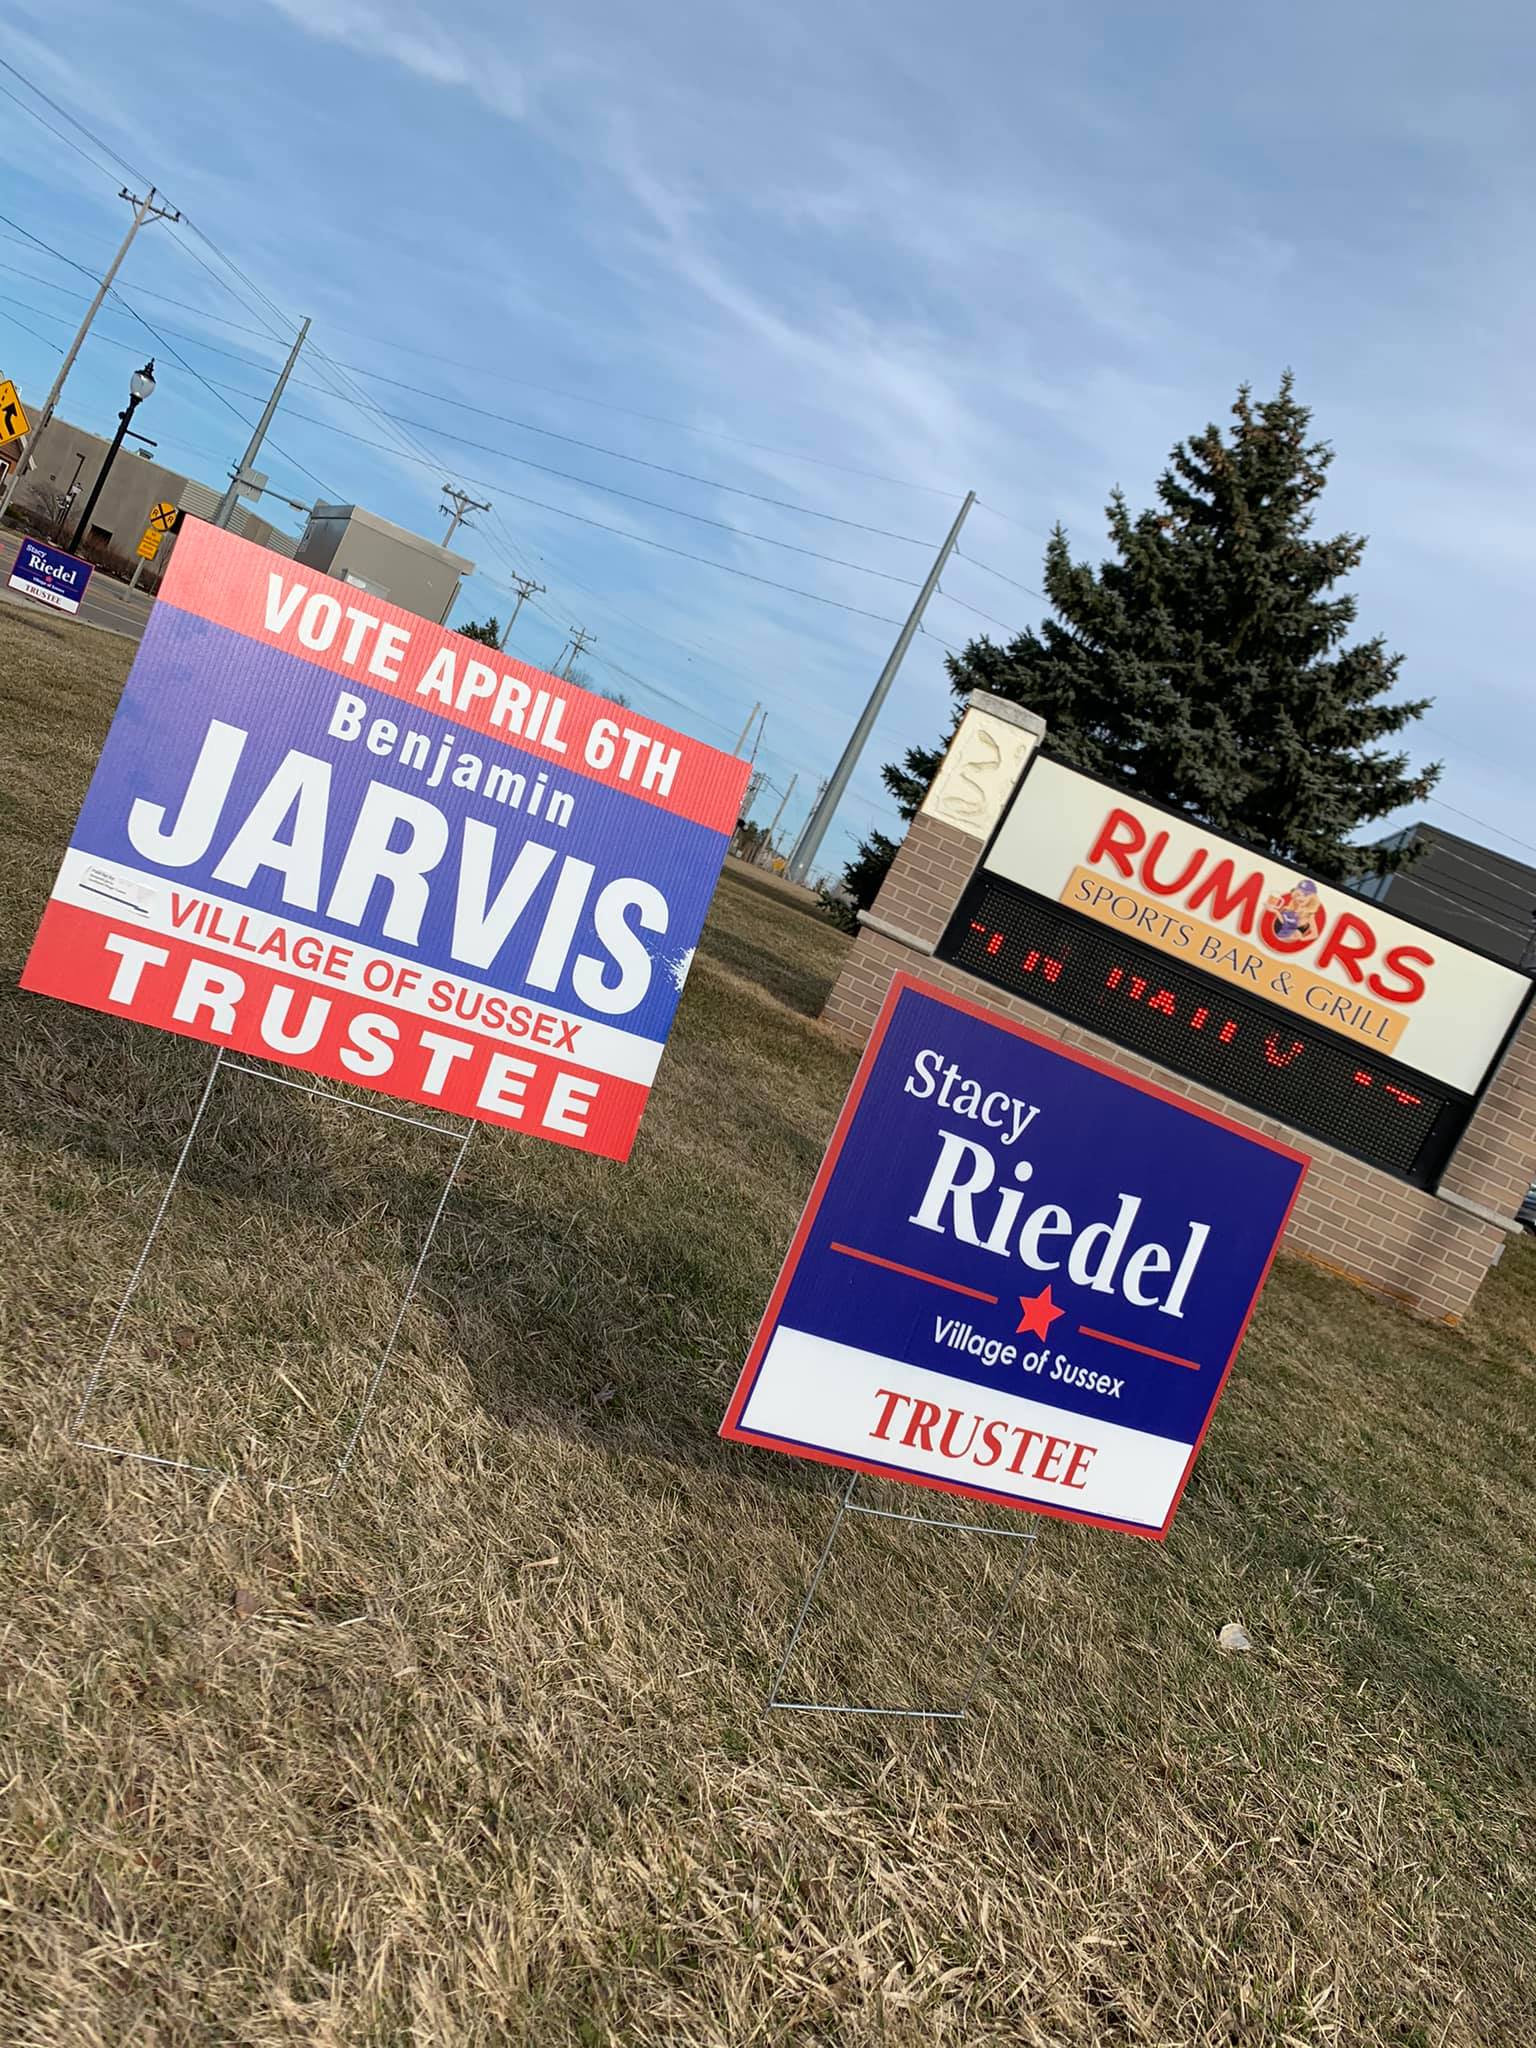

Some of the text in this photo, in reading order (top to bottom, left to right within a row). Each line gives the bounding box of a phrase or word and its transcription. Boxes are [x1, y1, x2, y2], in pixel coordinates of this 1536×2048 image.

[28, 554, 77, 585] Riedel
[264, 573, 682, 798] VOTE APRIL 6TH
[328, 691, 576, 829] Benjamin
[127, 718, 670, 1017] JARVIS
[1088, 808, 1434, 1004] RUMORS
[103, 933, 600, 1138] TRUSTEE
[170, 891, 582, 1054] VILLAGE OF SUSSEX
[1074, 879, 1391, 1042] SPORTS BAR & GRILL
[904, 1049, 1040, 1144] Stacy
[908, 1129, 1211, 1318] Riedel
[868, 1388, 1098, 1489] TRUSTEE
[933, 1316, 1125, 1398] Village of Sussex
